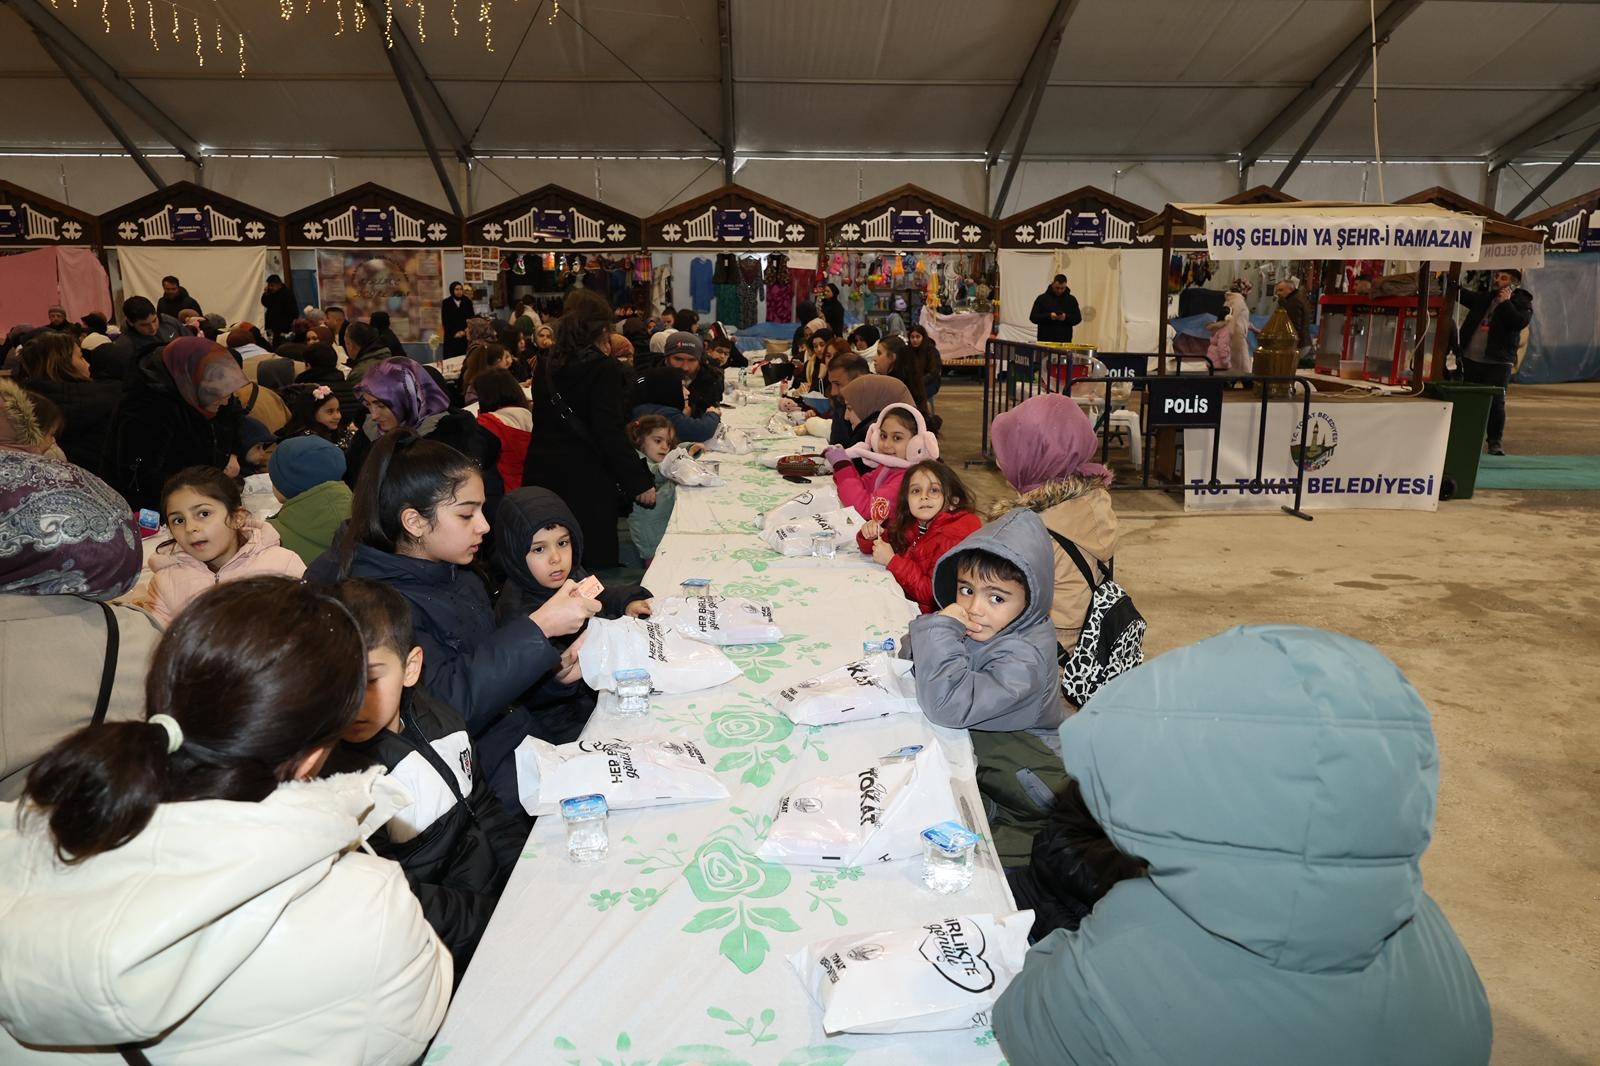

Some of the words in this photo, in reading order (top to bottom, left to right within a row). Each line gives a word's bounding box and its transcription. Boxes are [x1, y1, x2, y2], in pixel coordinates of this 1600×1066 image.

[1213, 228, 1246, 250] HOŞ
[1250, 225, 1308, 247] GELDİN
[1313, 228, 1333, 246] YA
[1336, 225, 1390, 251] ŞEHR-İ
[1394, 228, 1473, 249] RAMAZAN
[1105, 366, 1136, 378] OLİS
[1164, 394, 1209, 414] POLİS
[1295, 411, 1316, 431] TOAT
[1190, 478, 1228, 496] T.C.
[1307, 474, 1435, 496] BELEDİYESİ
[608, 759, 623, 784] HER
[858, 767, 877, 826] TOKAT
[944, 917, 981, 977] İRLİKTE
